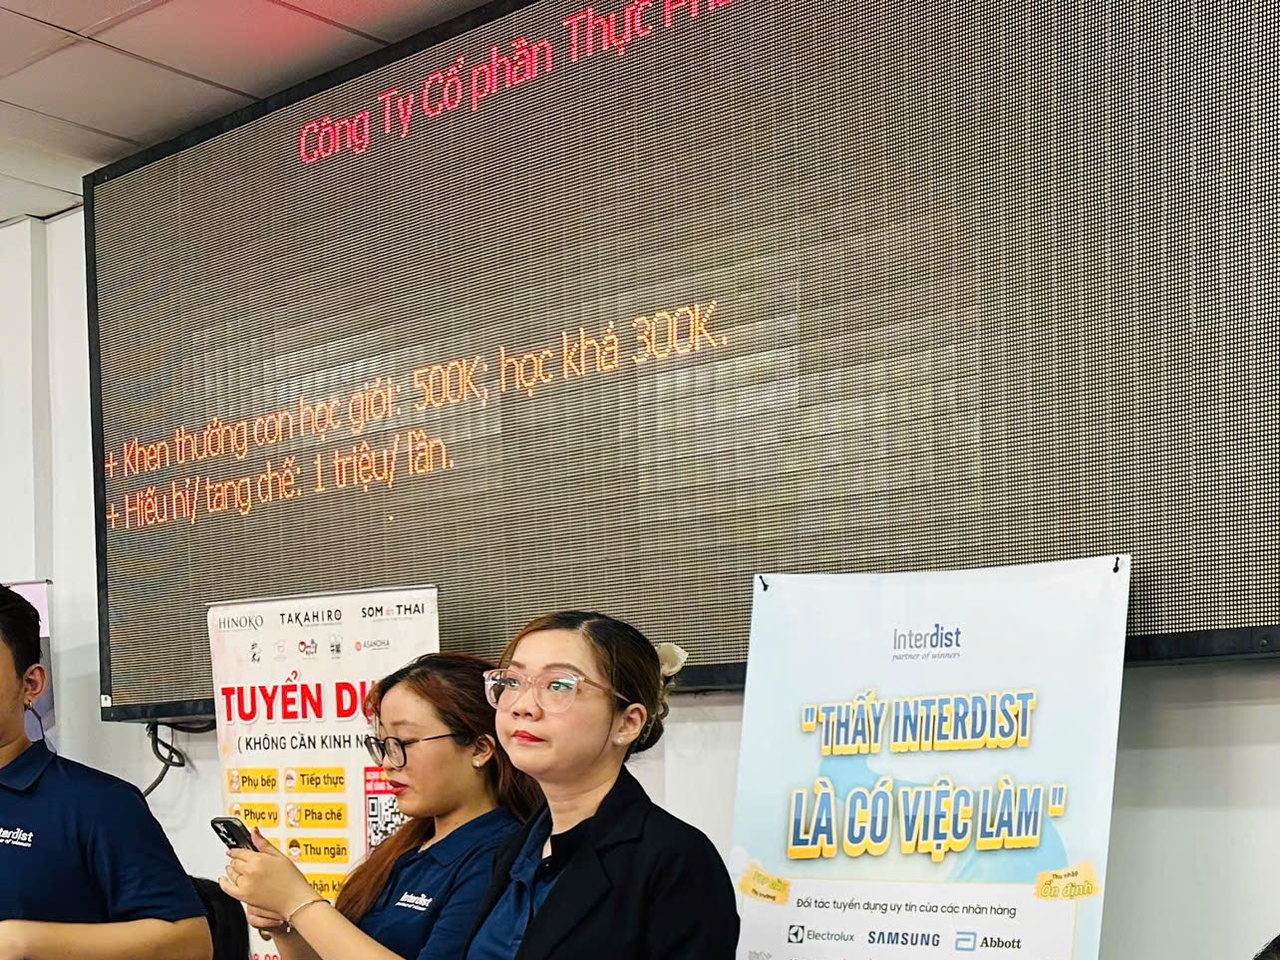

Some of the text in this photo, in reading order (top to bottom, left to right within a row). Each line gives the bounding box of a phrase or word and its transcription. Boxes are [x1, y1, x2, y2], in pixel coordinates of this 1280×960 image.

[299, 109, 371, 166] Công
[377, 87, 415, 139] Ty
[422, 55, 465, 119] Cổ
[469, 36, 555, 112] phần
[122, 437, 170, 477] Khen
[174, 416, 249, 461] thưởng
[253, 409, 294, 447] con
[298, 394, 342, 441] học
[499, 344, 554, 397] học
[562, 320, 621, 379] khá
[631, 299, 729, 365] 300K.
[124, 486, 168, 529] Hiếu
[205, 477, 252, 516] tang
[313, 453, 326, 493] 1
[279, 609, 343, 627] TAKAHIRO
[361, 603, 425, 618] SOM THAI
[218, 614, 264, 630] HINOKO
[893, 623, 962, 650] Interdist
[221, 670, 323, 722] TUYỂN
[893, 692, 1034, 744] INTERDIST
[290, 731, 321, 749] CẦN
[321, 735, 352, 749] KINH
[241, 774, 277, 791] Phụ bếp
[300, 773, 345, 788] Tiếp thực
[243, 809, 278, 823] Phục vụ
[304, 808, 343, 821] Pha chế
[791, 778, 1042, 849] LÀ CÓ VIỆC LÀM
[303, 843, 347, 859] Thu ngân
[862, 900, 888, 914] dụng
[890, 904, 902, 914] uy
[807, 929, 855, 942] Electrolux
[867, 930, 941, 948] SAMSUNG
[980, 936, 1022, 949] Abbott
